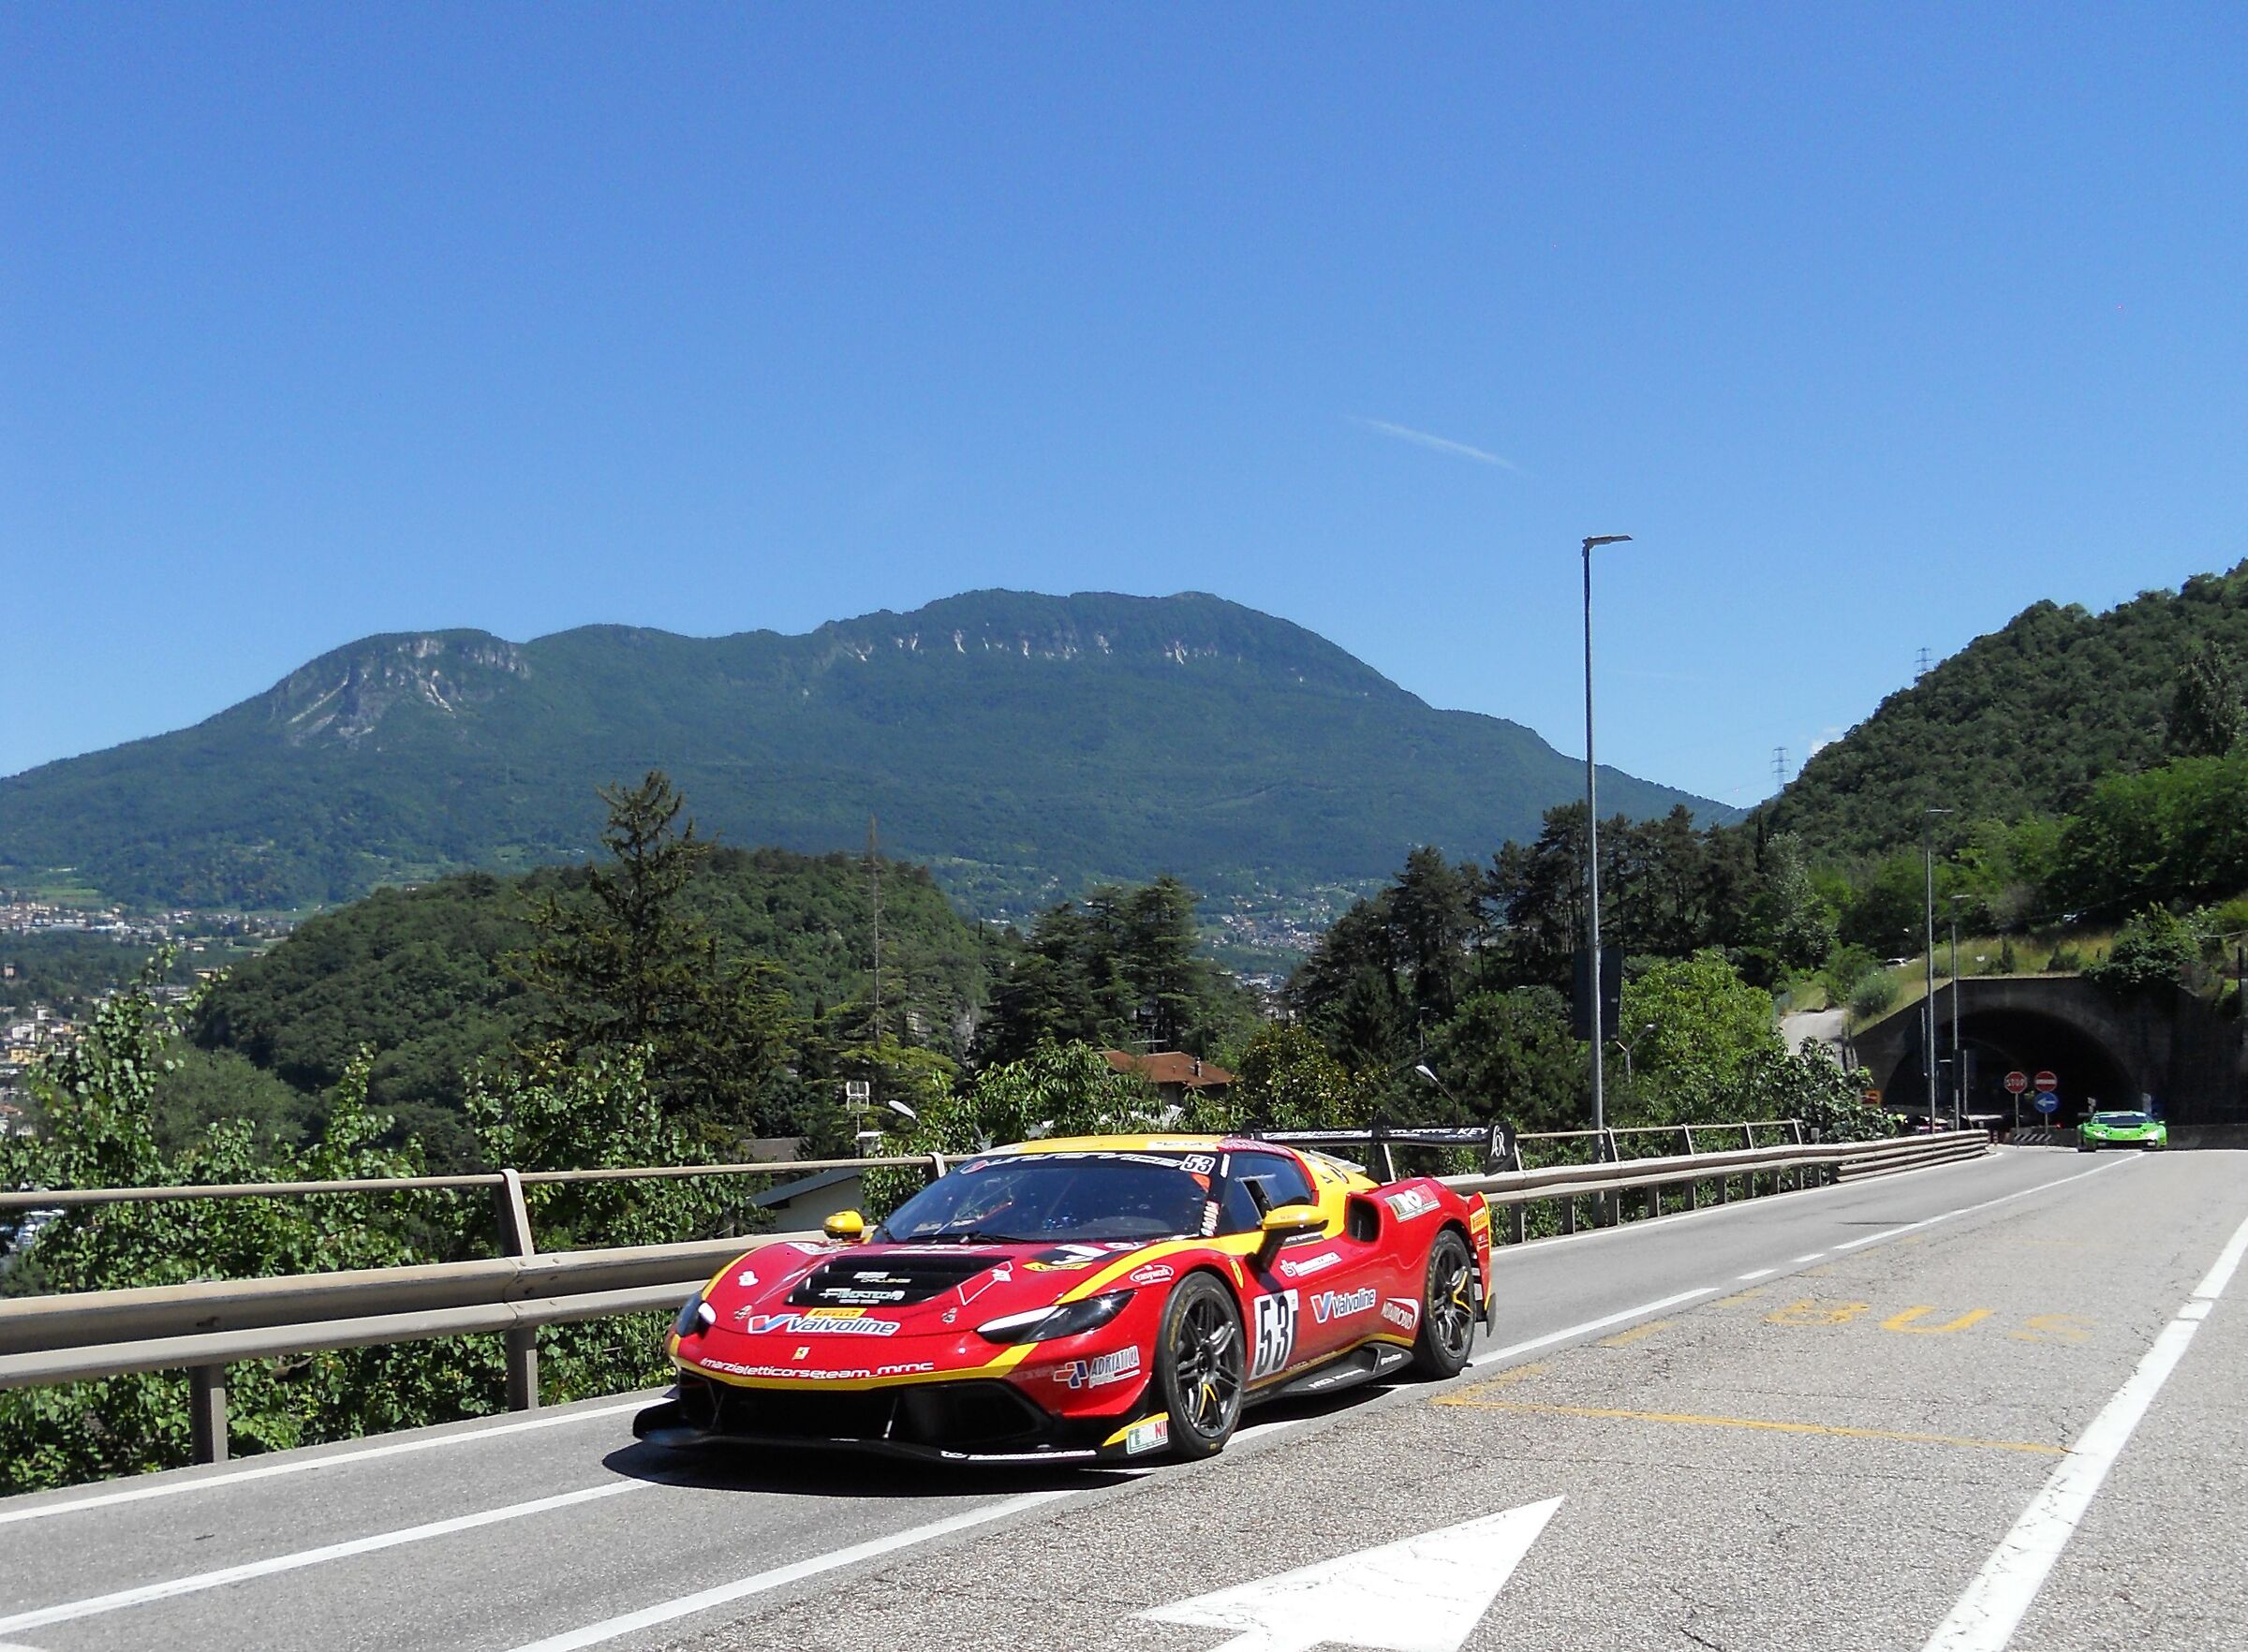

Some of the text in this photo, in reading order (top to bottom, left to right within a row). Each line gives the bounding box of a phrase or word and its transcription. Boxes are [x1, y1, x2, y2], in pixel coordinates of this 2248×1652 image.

[2005, 1078, 2025, 1086] STOP
[1457, 1127, 1489, 1136] KEY
[1183, 1155, 1212, 1173] 53
[1332, 1289, 1376, 1318] Valvoline
[790, 1316, 899, 1335] Valvoline
[1255, 1294, 1291, 1376] 53
